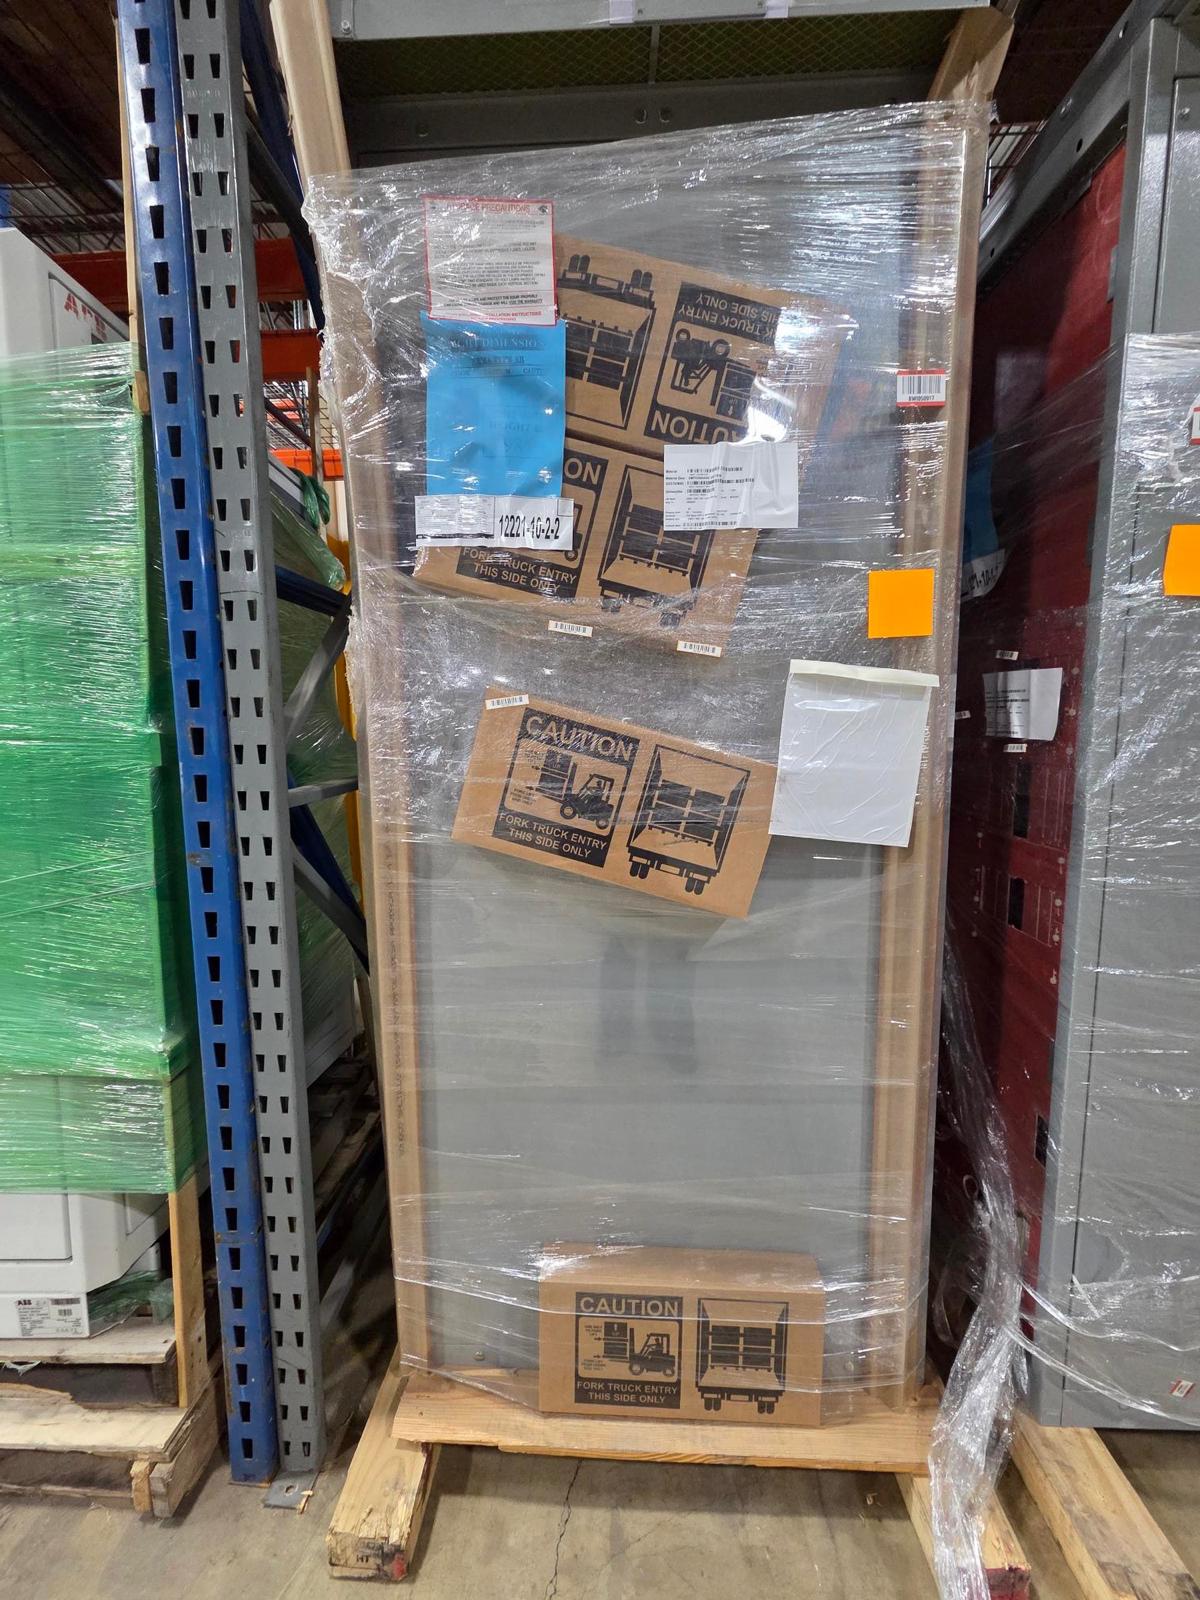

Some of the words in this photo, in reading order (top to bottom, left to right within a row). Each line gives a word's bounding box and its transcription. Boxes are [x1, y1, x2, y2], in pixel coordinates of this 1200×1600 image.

[696, 293, 728, 310] ONLY
[732, 302, 758, 319] SIDE
[678, 304, 717, 323] ENTRY
[720, 315, 761, 335] TRUCK
[651, 410, 738, 444] UTION
[499, 514, 561, 540] 12221-10-2-2
[473, 562, 498, 578] THIS
[501, 570, 528, 586] SIDE
[530, 578, 561, 594] ONLY
[538, 566, 578, 584] ENTRY
[525, 716, 634, 761] CAUTION
[499, 812, 529, 830] FORK
[532, 821, 568, 841] TRUCK
[570, 832, 608, 851] ENTRY
[509, 828, 533, 842] THIS
[534, 835, 560, 850] SIDE
[562, 843, 592, 859] ONLY
[580, 1296, 679, 1317] CAUTION
[577, 1381, 605, 1390] FORK
[607, 1382, 642, 1393] TRUCK
[644, 1384, 678, 1394] ENTRY
[588, 1391, 612, 1401] THIS
[613, 1393, 637, 1402] SIDE
[639, 1394, 666, 1404] ONLY
